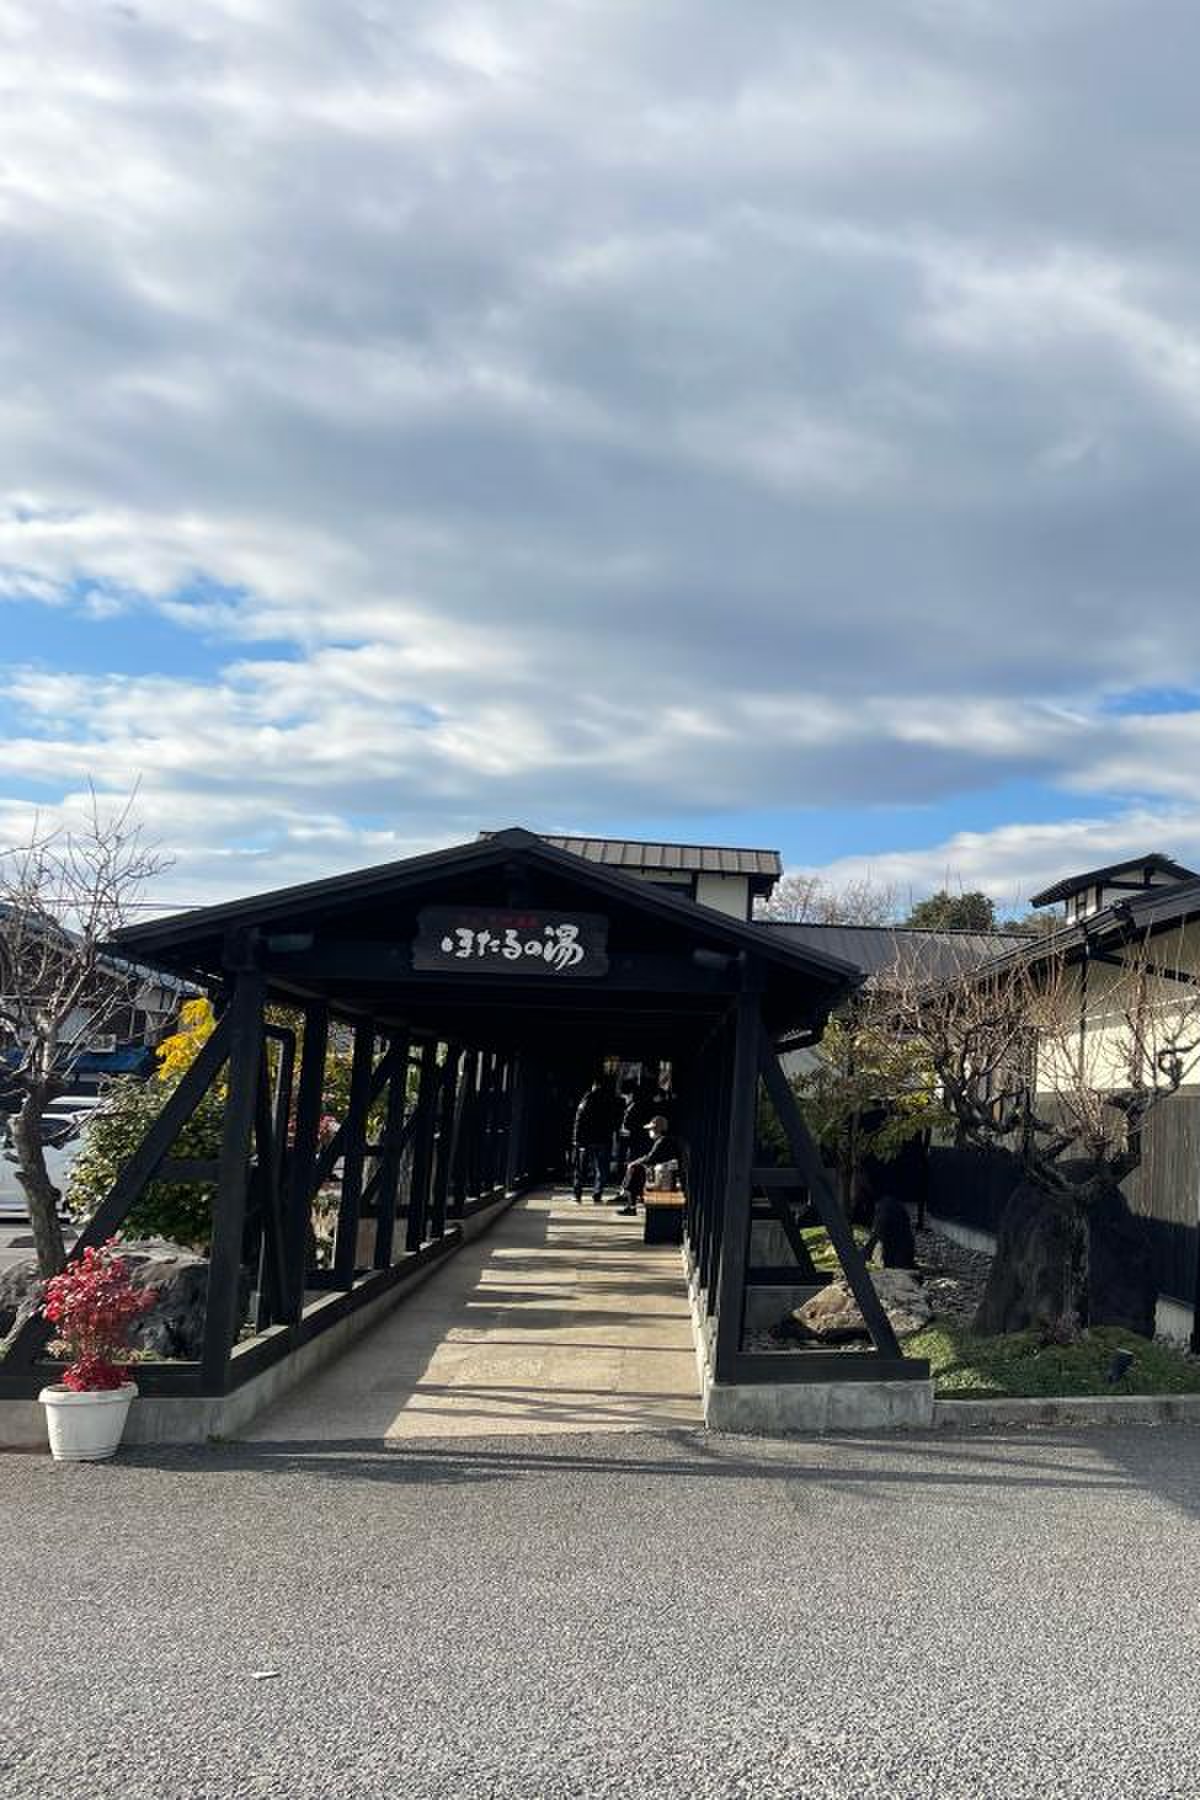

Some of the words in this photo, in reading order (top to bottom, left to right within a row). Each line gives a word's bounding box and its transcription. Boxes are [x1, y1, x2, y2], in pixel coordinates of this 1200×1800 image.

[441, 924, 584, 970] ほたるの湯
